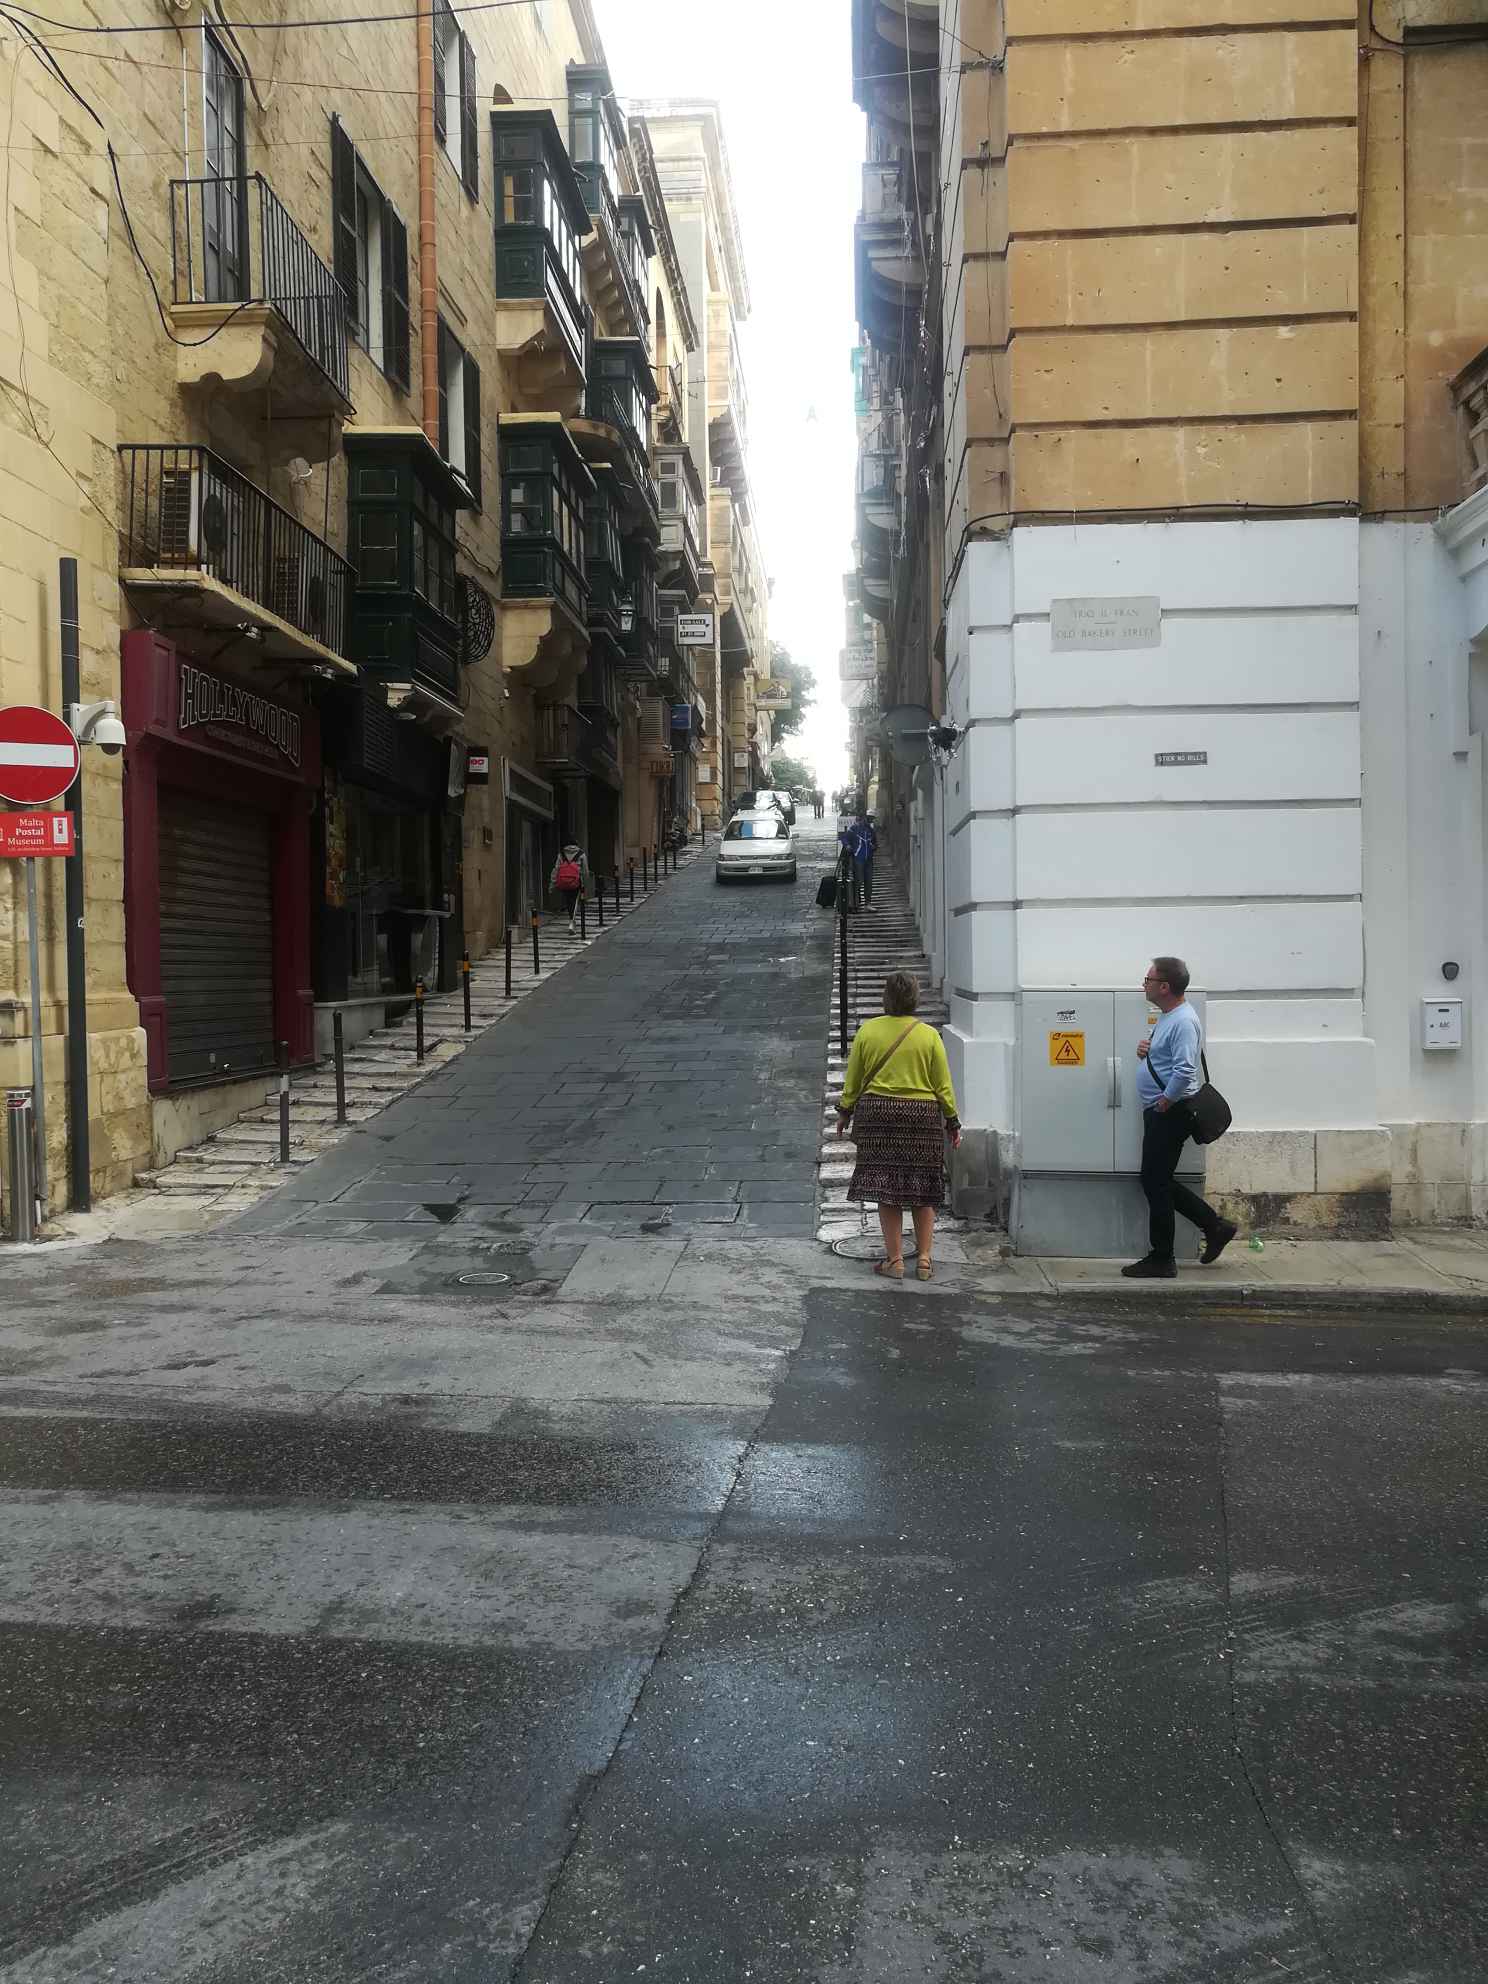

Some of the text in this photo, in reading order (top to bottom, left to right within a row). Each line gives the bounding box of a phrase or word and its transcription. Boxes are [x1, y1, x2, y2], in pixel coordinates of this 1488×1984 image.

[1056, 627, 1154, 640] OLD BAKERY STREET
[180, 664, 300, 767] HOLLYWOOD
[19, 818, 44, 827] Malta
[15, 828, 44, 836] Postal
[7, 838, 45, 846] Museum
